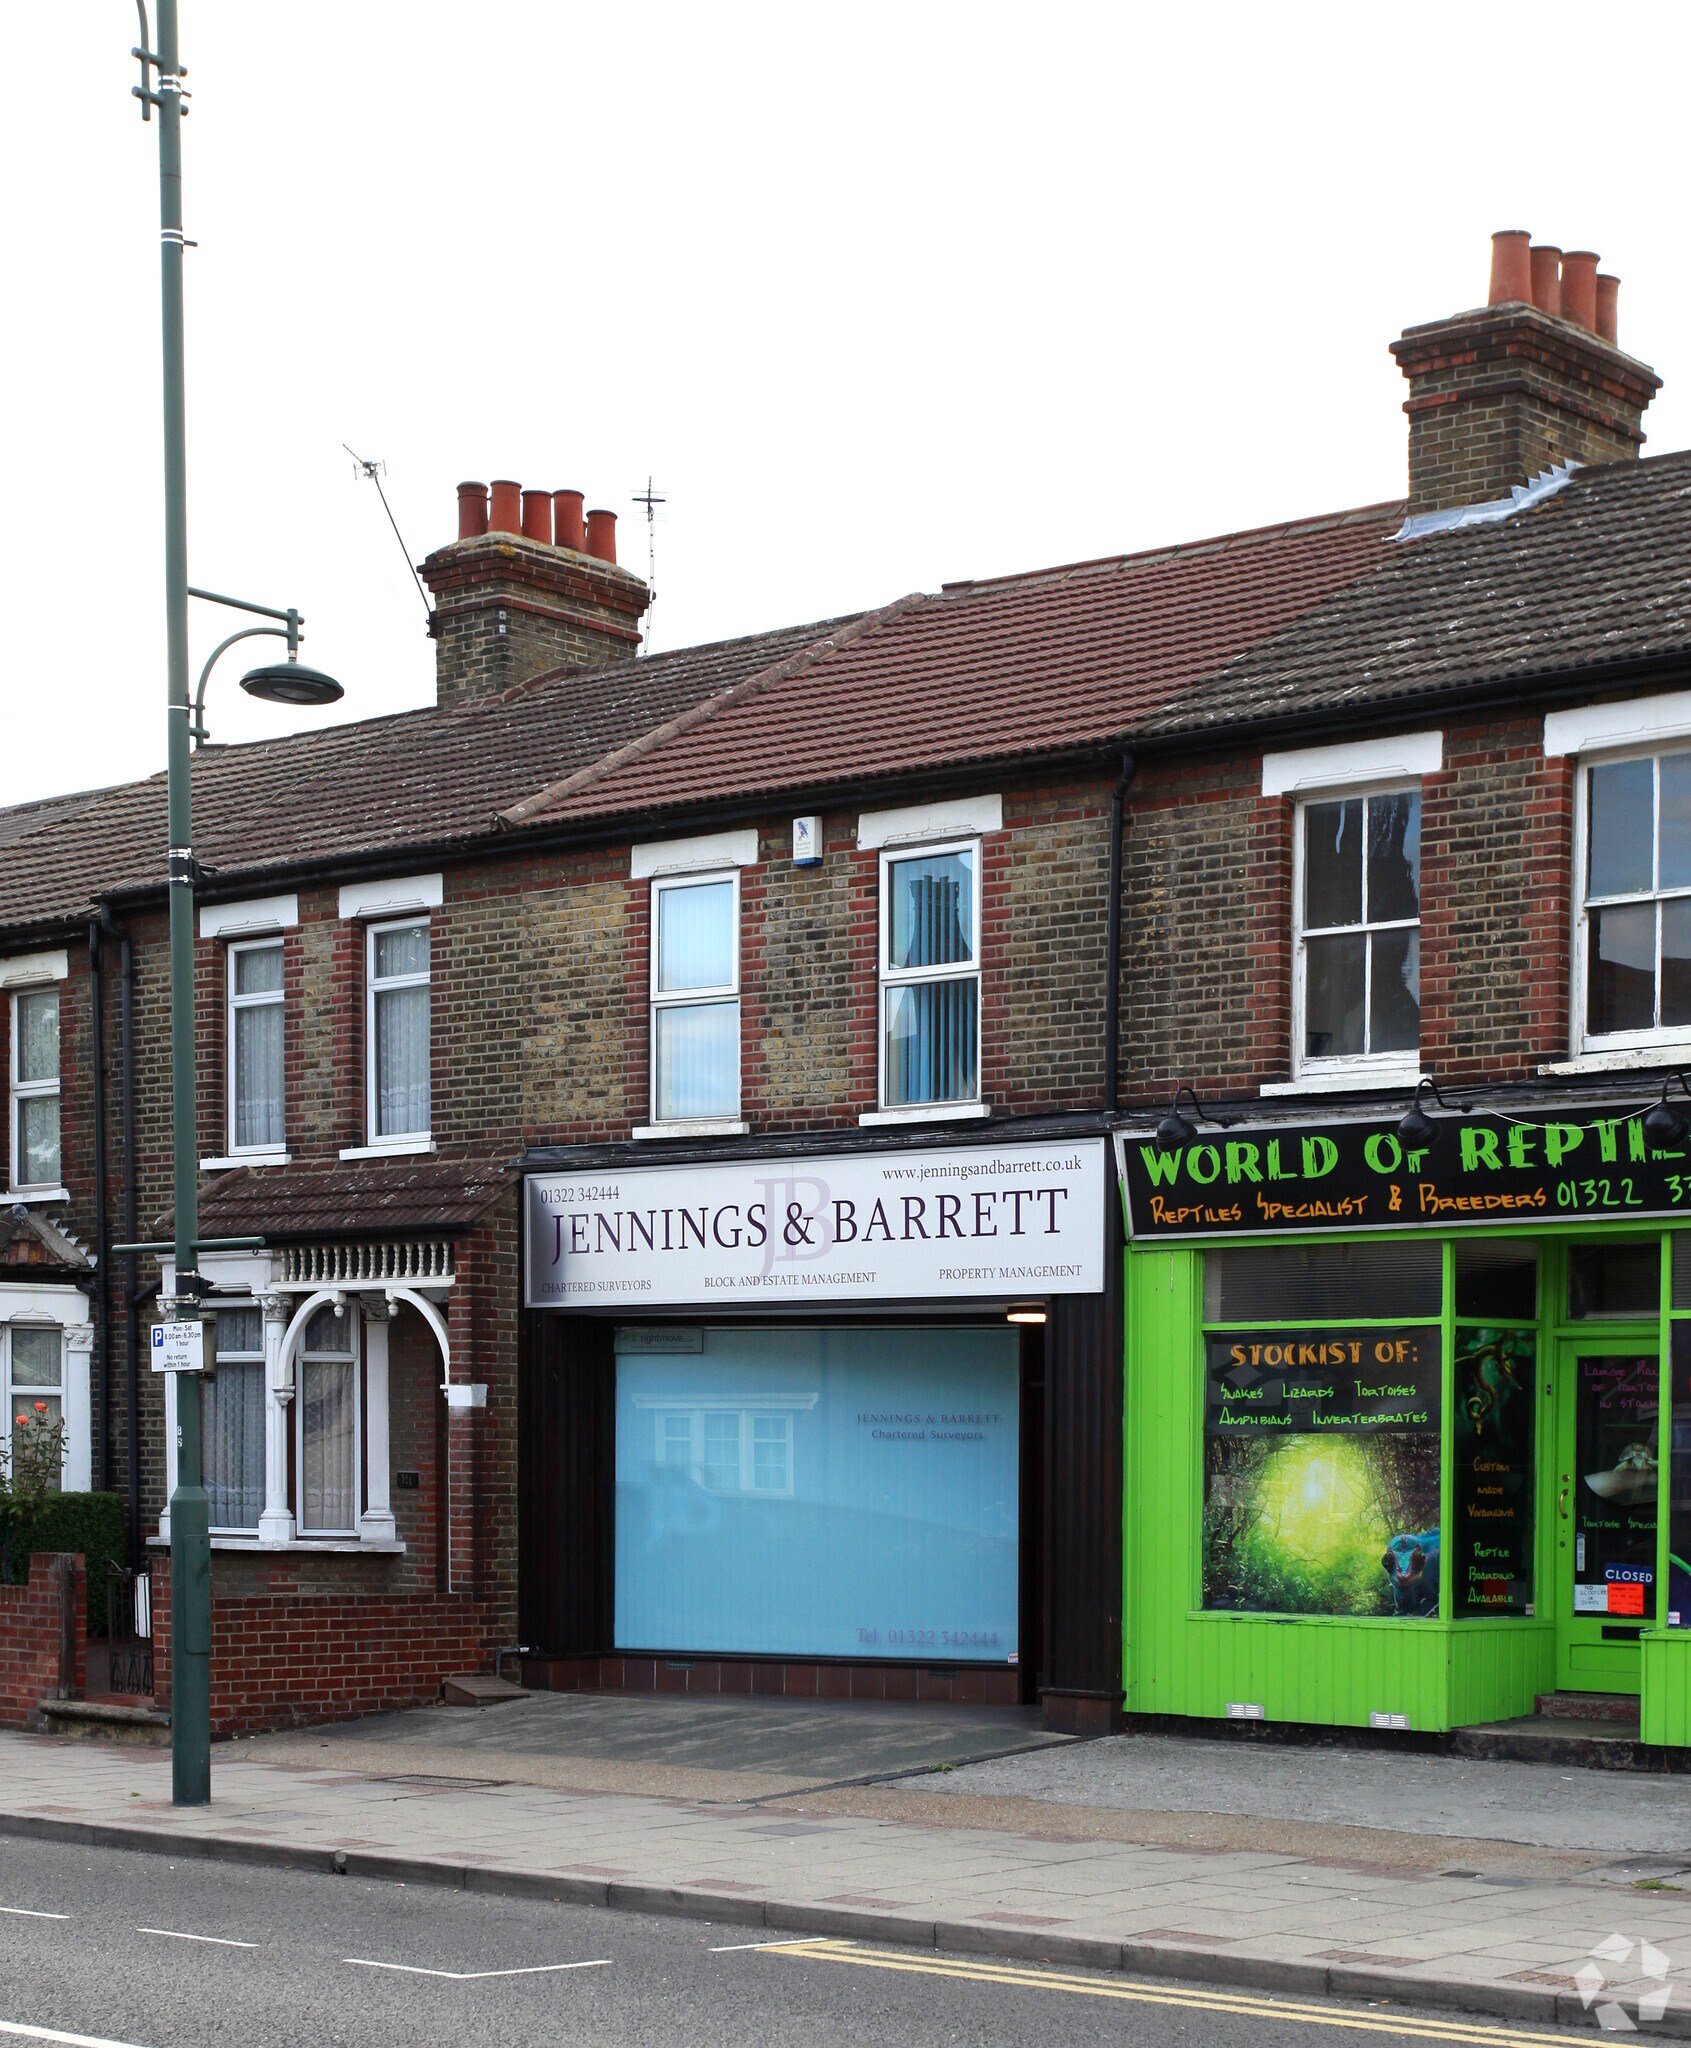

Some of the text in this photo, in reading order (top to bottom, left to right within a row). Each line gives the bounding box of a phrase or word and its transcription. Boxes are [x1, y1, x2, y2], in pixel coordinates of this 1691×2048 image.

[1139, 1136, 1339, 1187] WORLD
[1460, 1117, 1691, 1173] REPTI
[882, 1155, 1082, 1182] www.jenningsandbarrett.co.uk
[541, 1185, 620, 1204] 01322 342444
[1557, 1177, 1644, 1209] 01322
[1150, 1183, 1547, 1225] REPTILES SPECIALIST & BREEDERS
[551, 1188, 1068, 1265] JENNINGS & BARRETT
[704, 1272, 877, 1288] BLOCK AND ESTATE MANAGEMENT
[939, 1264, 1083, 1280] PROPERTY MANAGEMENT
[541, 1279, 652, 1294] CHARTERED SURVEYORS
[1229, 1340, 1418, 1367] STOCKIST OF:
[1220, 1380, 1416, 1400] SNAKES LIZARDS TORTOISES
[857, 1414, 1000, 1424] JENNINGS & BARRETT
[871, 1429, 984, 1441] Chartered Surveyors
[1473, 1456, 1510, 1472] CUSTOM
[1605, 1569, 1653, 1583] CLOSED
[856, 1628, 999, 1647] Tel. 01322 342444
